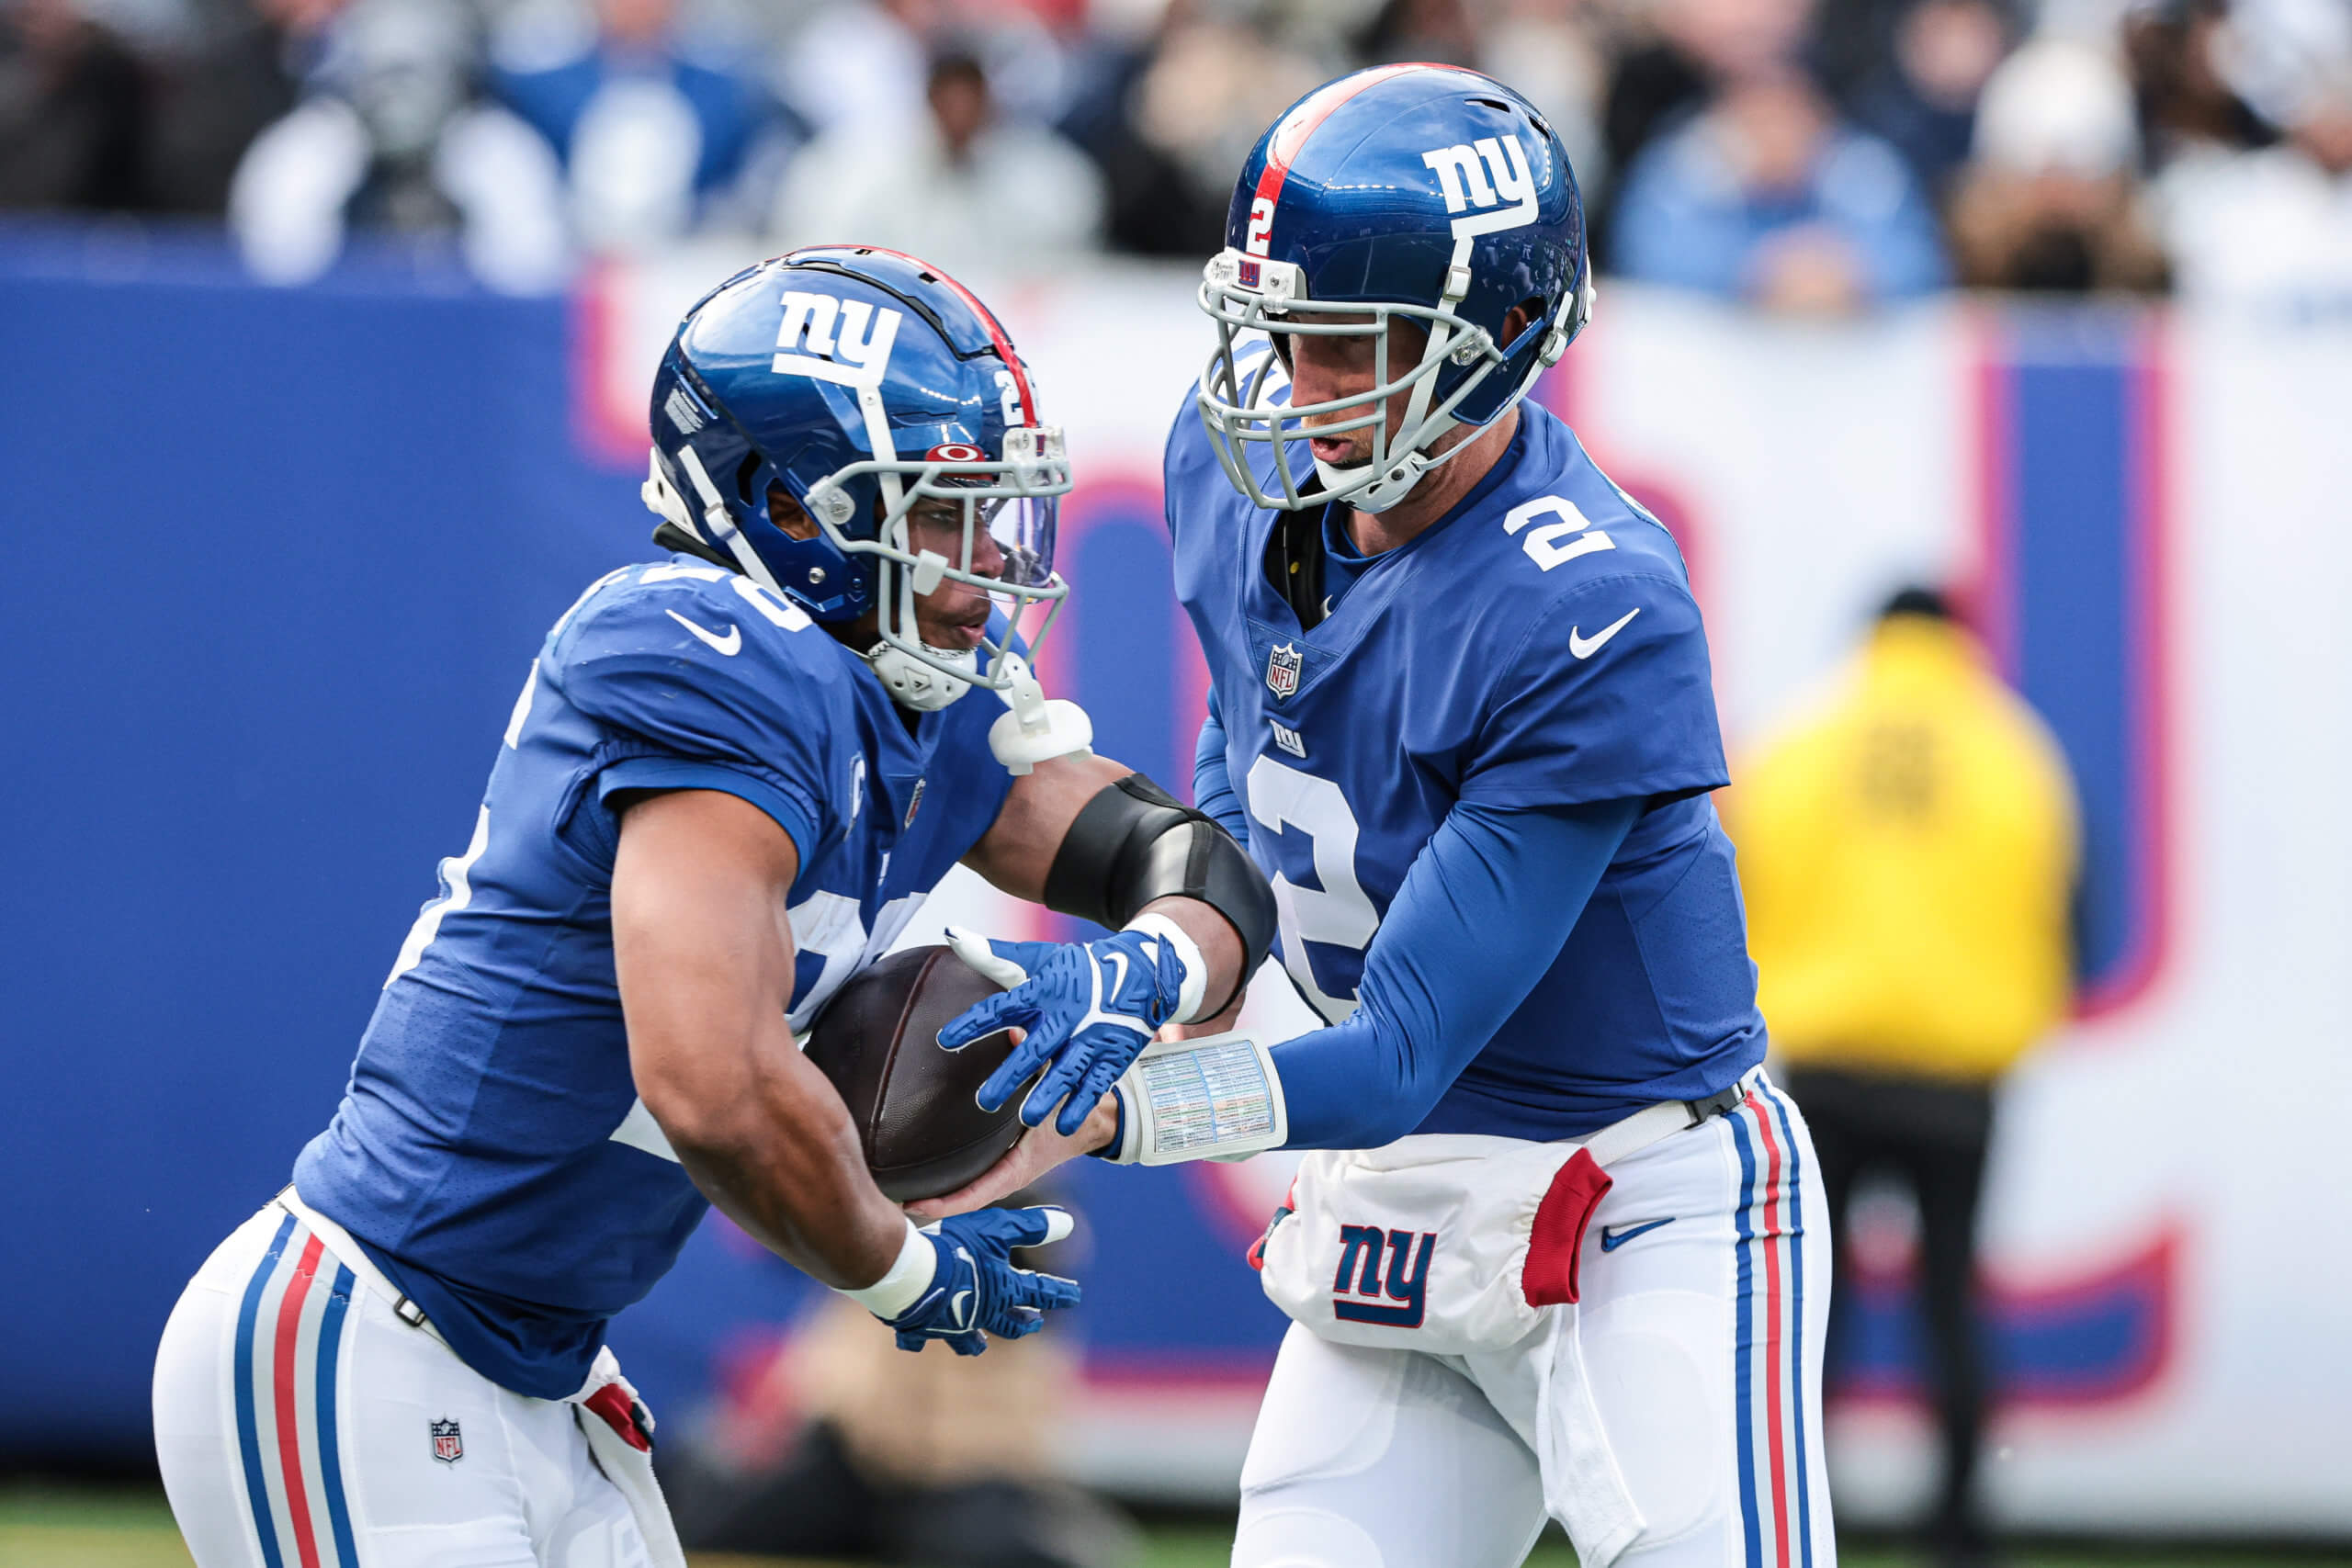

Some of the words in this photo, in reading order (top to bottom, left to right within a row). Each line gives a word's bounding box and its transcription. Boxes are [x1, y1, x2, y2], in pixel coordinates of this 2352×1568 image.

[1245, 196, 1275, 257] 2
[1503, 494, 1616, 572] 2
[1271, 665, 1295, 689] NFL
[1247, 753, 1379, 1027] 2
[435, 1437, 463, 1458] NFL
